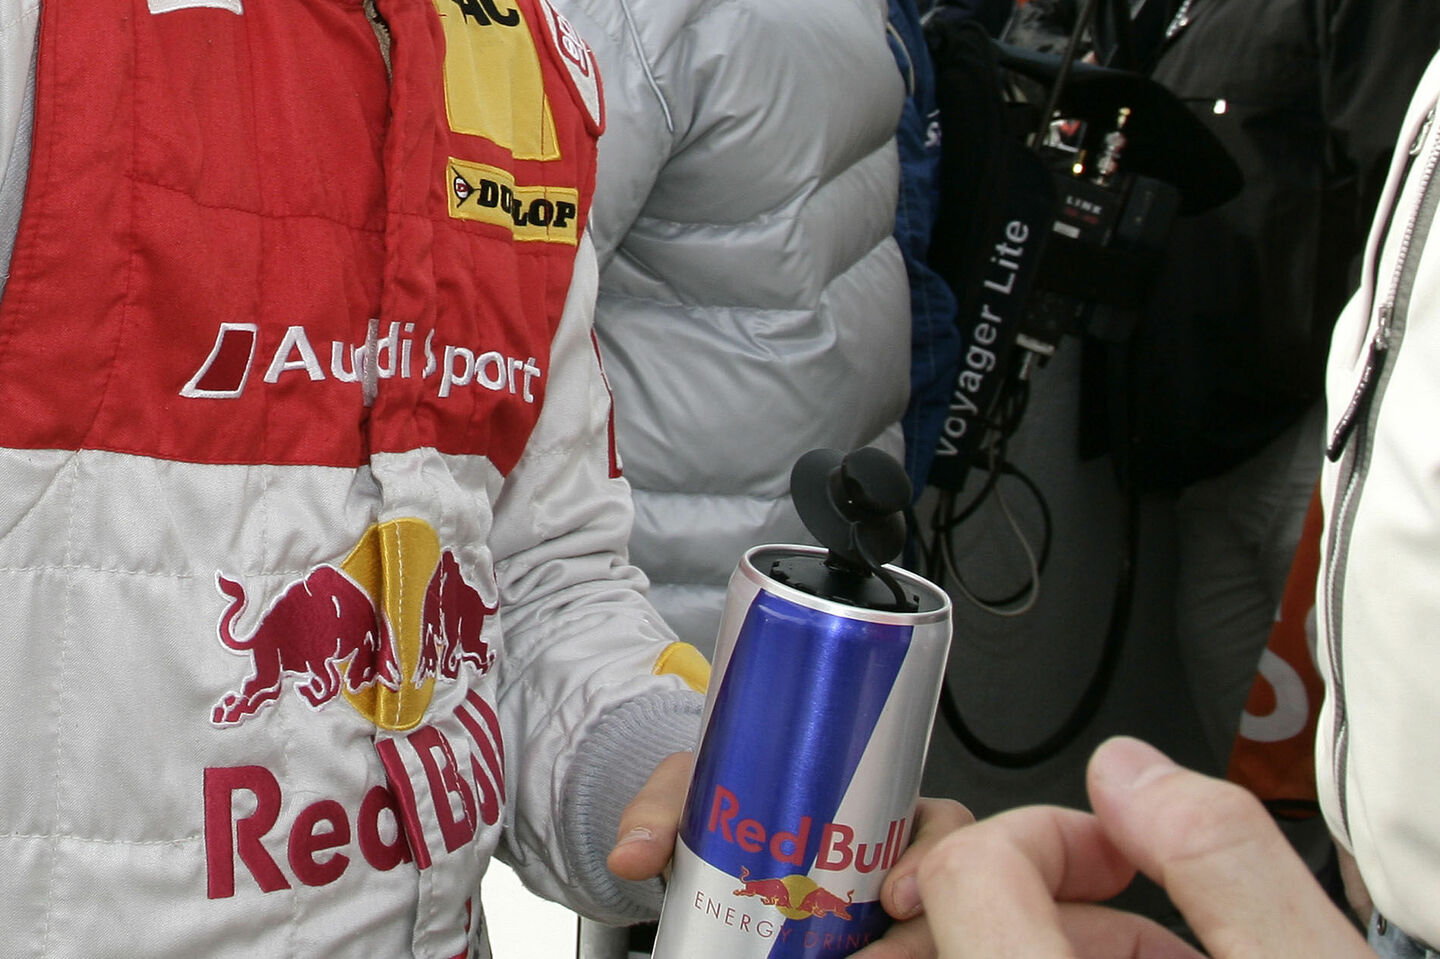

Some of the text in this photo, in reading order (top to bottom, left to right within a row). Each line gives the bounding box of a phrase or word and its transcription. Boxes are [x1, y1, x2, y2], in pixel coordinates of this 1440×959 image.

[983, 219, 1031, 296] Lite
[263, 320, 415, 398] Audi
[203, 688, 506, 900] Red Bull
[708, 784, 906, 874] Red Bull
[694, 890, 792, 943] ENERGY
